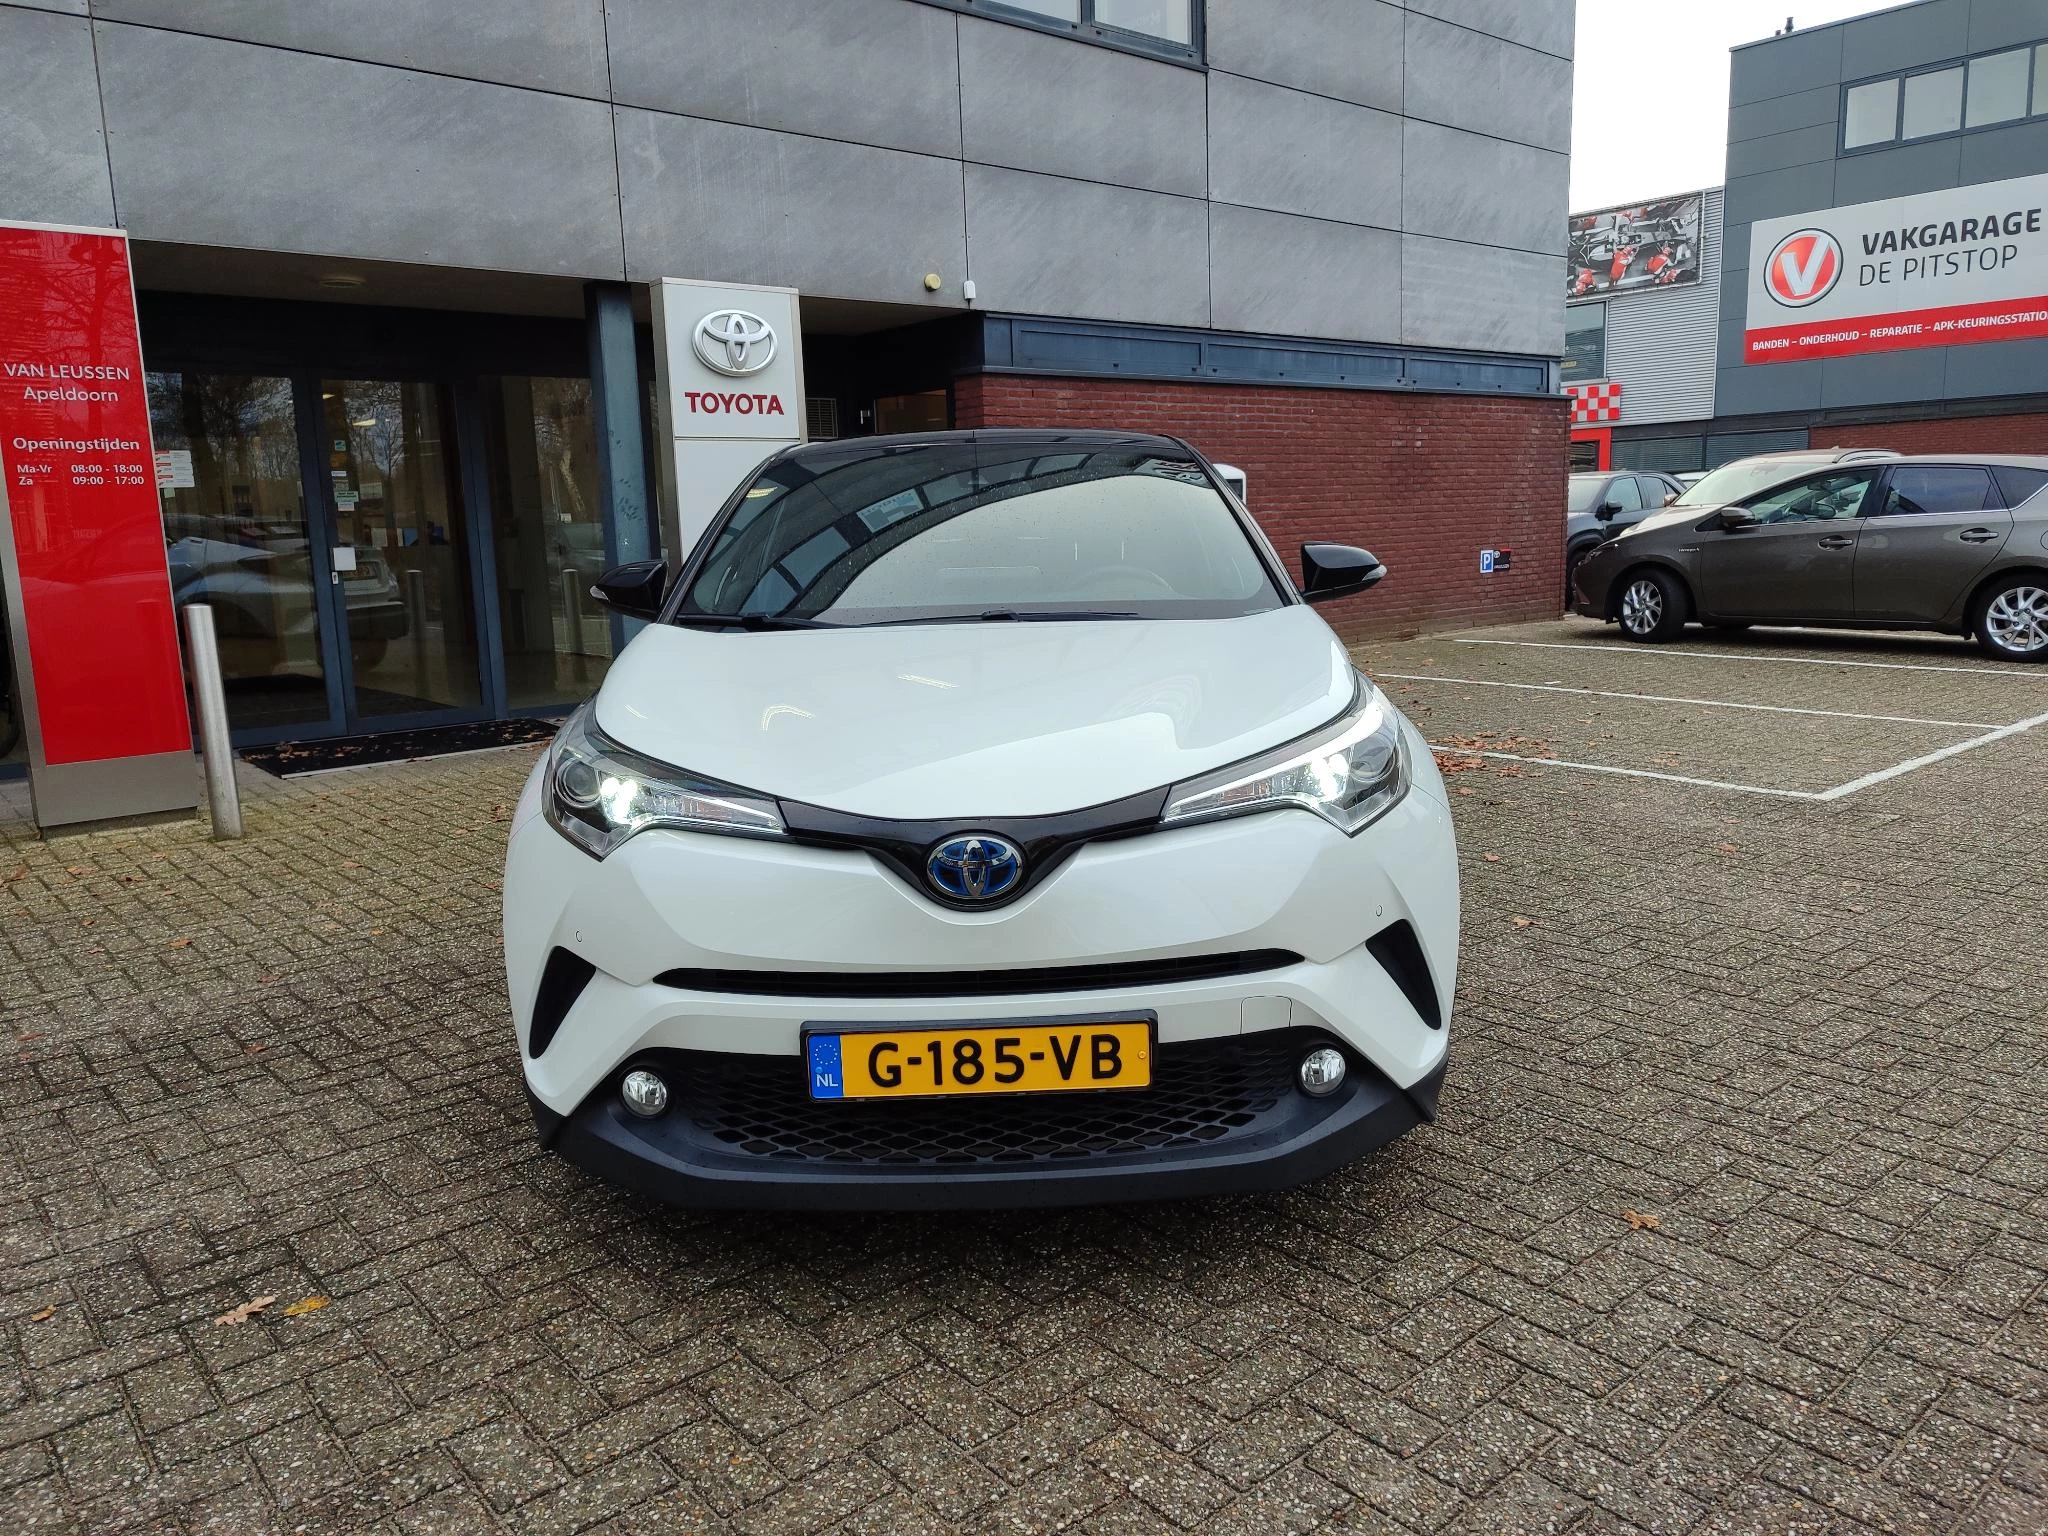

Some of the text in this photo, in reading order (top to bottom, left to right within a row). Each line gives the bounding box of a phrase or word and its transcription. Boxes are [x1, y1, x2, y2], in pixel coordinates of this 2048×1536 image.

[1862, 208, 2042, 256] VAKGARAGE
[1859, 244, 2018, 287] DE PITSTOP
[1752, 338, 1790, 351] BANDEN
[1799, 330, 1860, 346] ONDERHOUD
[1869, 323, 1923, 338] REPARATIE
[1933, 310, 2048, 332] APK-KEURINGSSTATIO
[4, 363, 130, 381] VAN LEUSSEN
[23, 386, 119, 403] Apeldoorn
[685, 391, 785, 416] TOYOTA
[12, 437, 141, 454] Openingstijden
[16, 464, 53, 474] Ma-Vr
[70, 464, 103, 474] 08:00
[113, 464, 143, 474] 18:00
[18, 476, 34, 486] Za
[72, 476, 104, 486] 09:00
[114, 476, 145, 486] 17:00
[1483, 553, 1491, 570] P
[868, 1033, 1123, 1088] G-185-VB
[816, 1073, 839, 1088] NL
